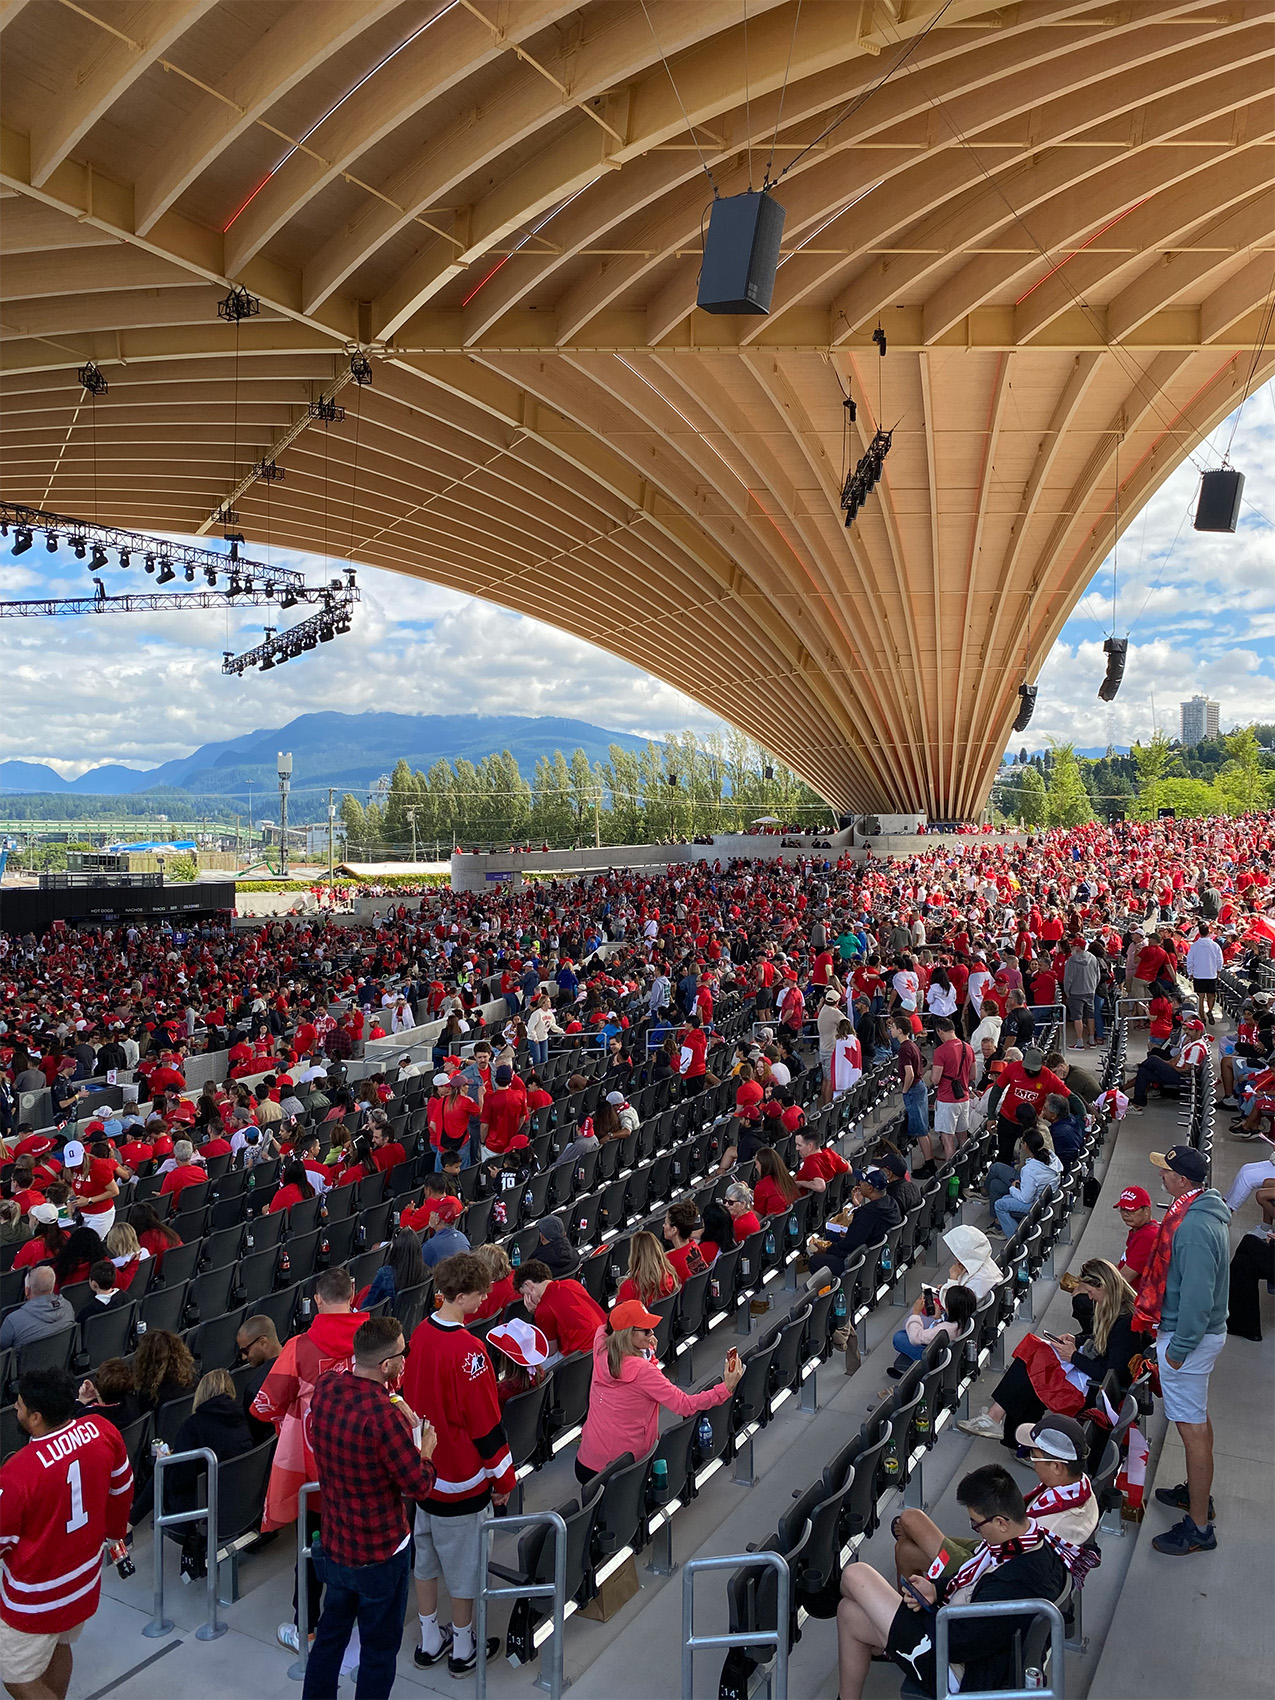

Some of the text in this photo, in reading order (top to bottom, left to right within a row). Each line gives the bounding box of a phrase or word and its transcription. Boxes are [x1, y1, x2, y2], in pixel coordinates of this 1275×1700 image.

[501, 1177, 515, 1190] 10
[468, 1365, 489, 1382] CANADA
[36, 1421, 100, 1469] LUONGO
[66, 1459, 89, 1534] 1
[511, 1635, 522, 1646] 13
[724, 1687, 736, 1699] 14
